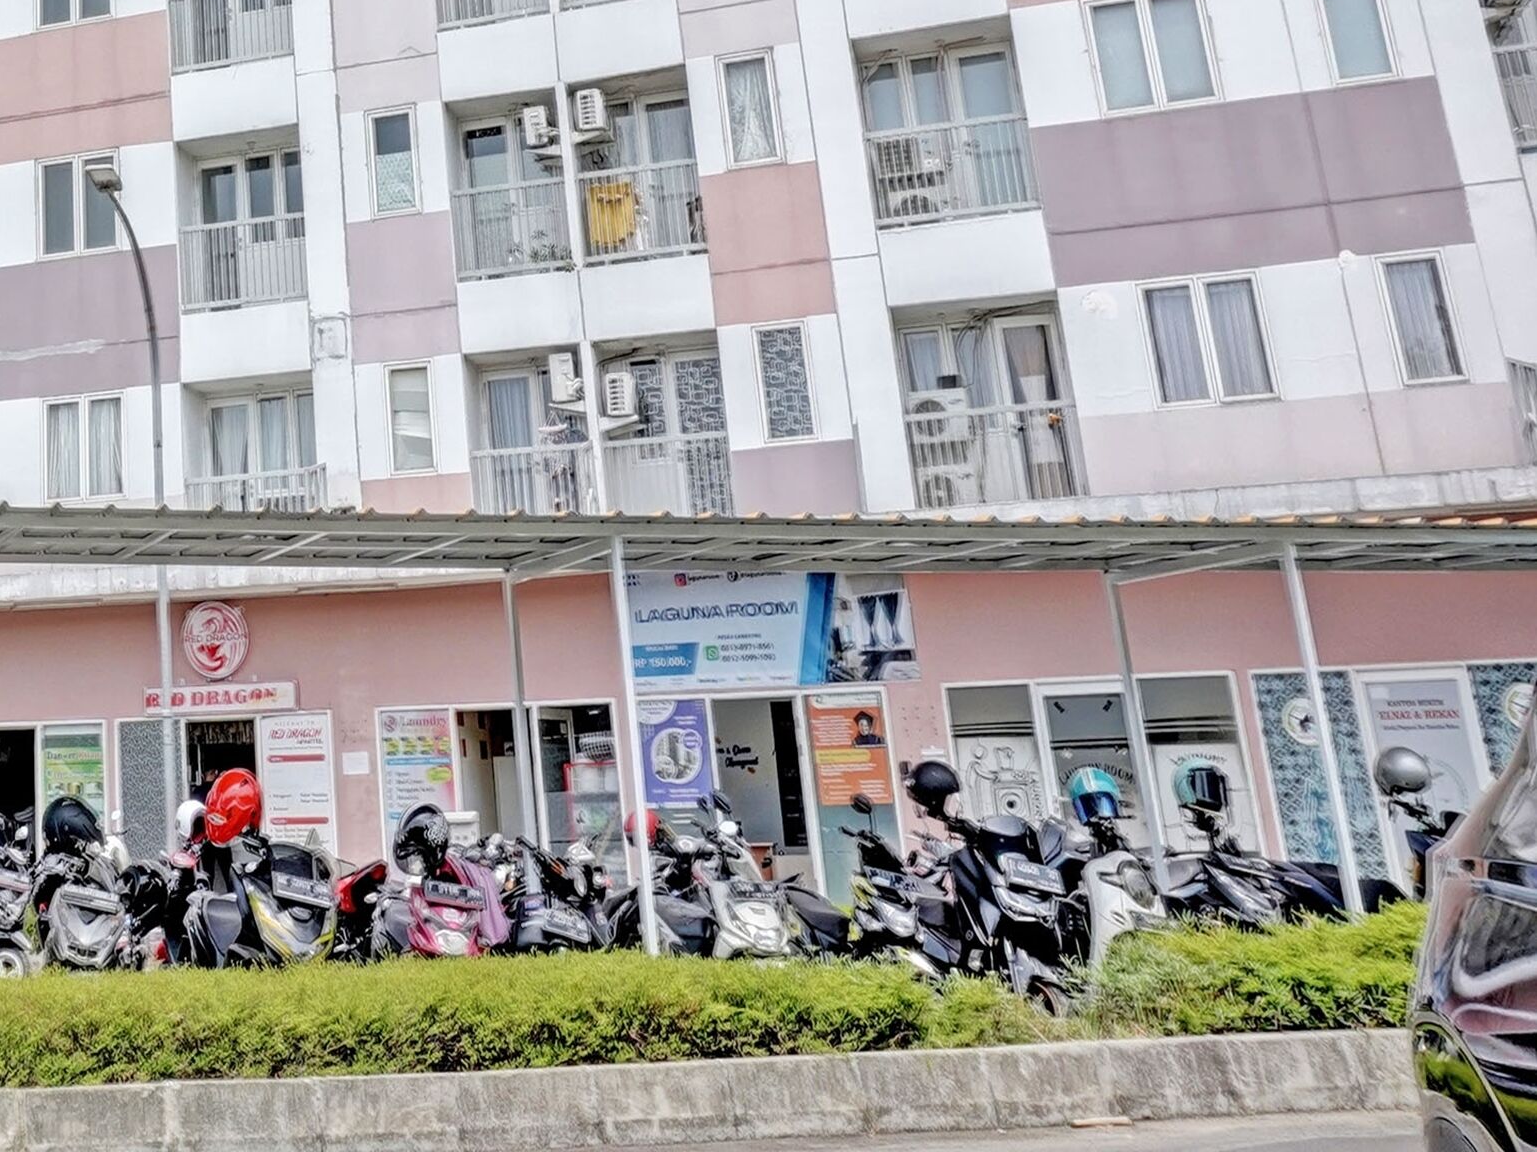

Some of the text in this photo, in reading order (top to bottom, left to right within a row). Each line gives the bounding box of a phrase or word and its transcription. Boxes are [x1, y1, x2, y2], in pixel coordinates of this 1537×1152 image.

[635, 600, 800, 624] LAGUNA ROOM
[184, 632, 248, 643] RED DRAGON
[145, 687, 278, 708] RD DRAGON
